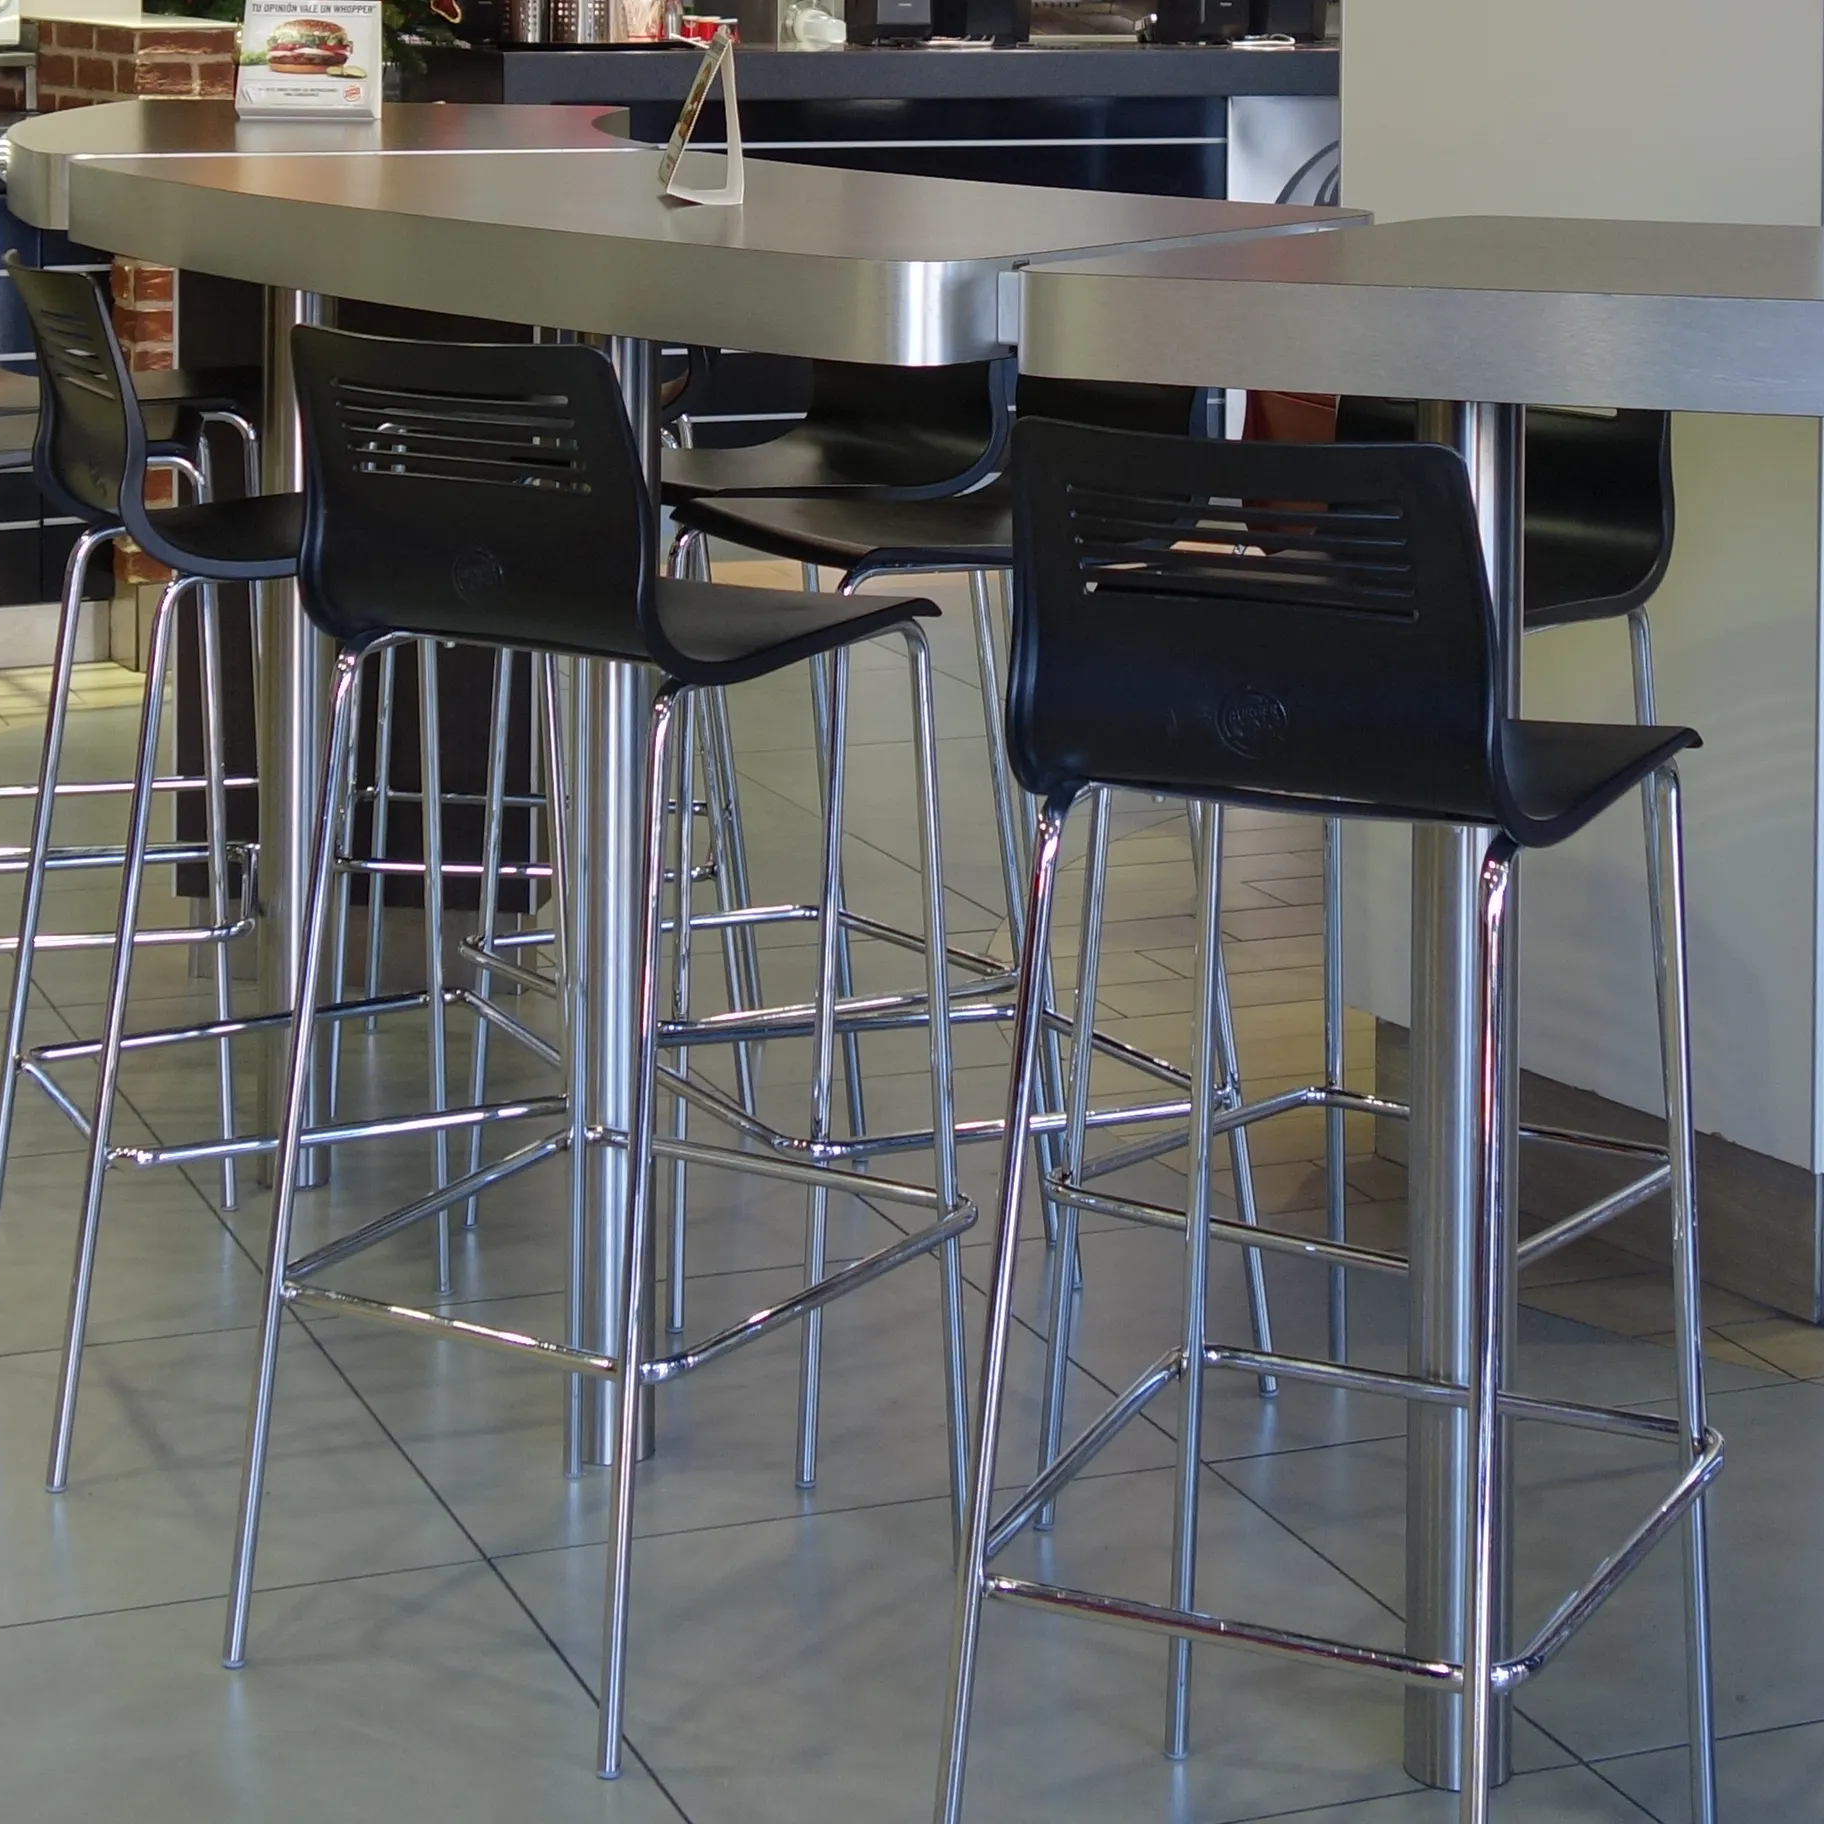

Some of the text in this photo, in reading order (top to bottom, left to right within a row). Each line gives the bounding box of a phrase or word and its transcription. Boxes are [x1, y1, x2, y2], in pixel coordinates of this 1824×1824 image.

[251, 2, 373, 15] TU OPINIÓN VALE UN WHOPPER
